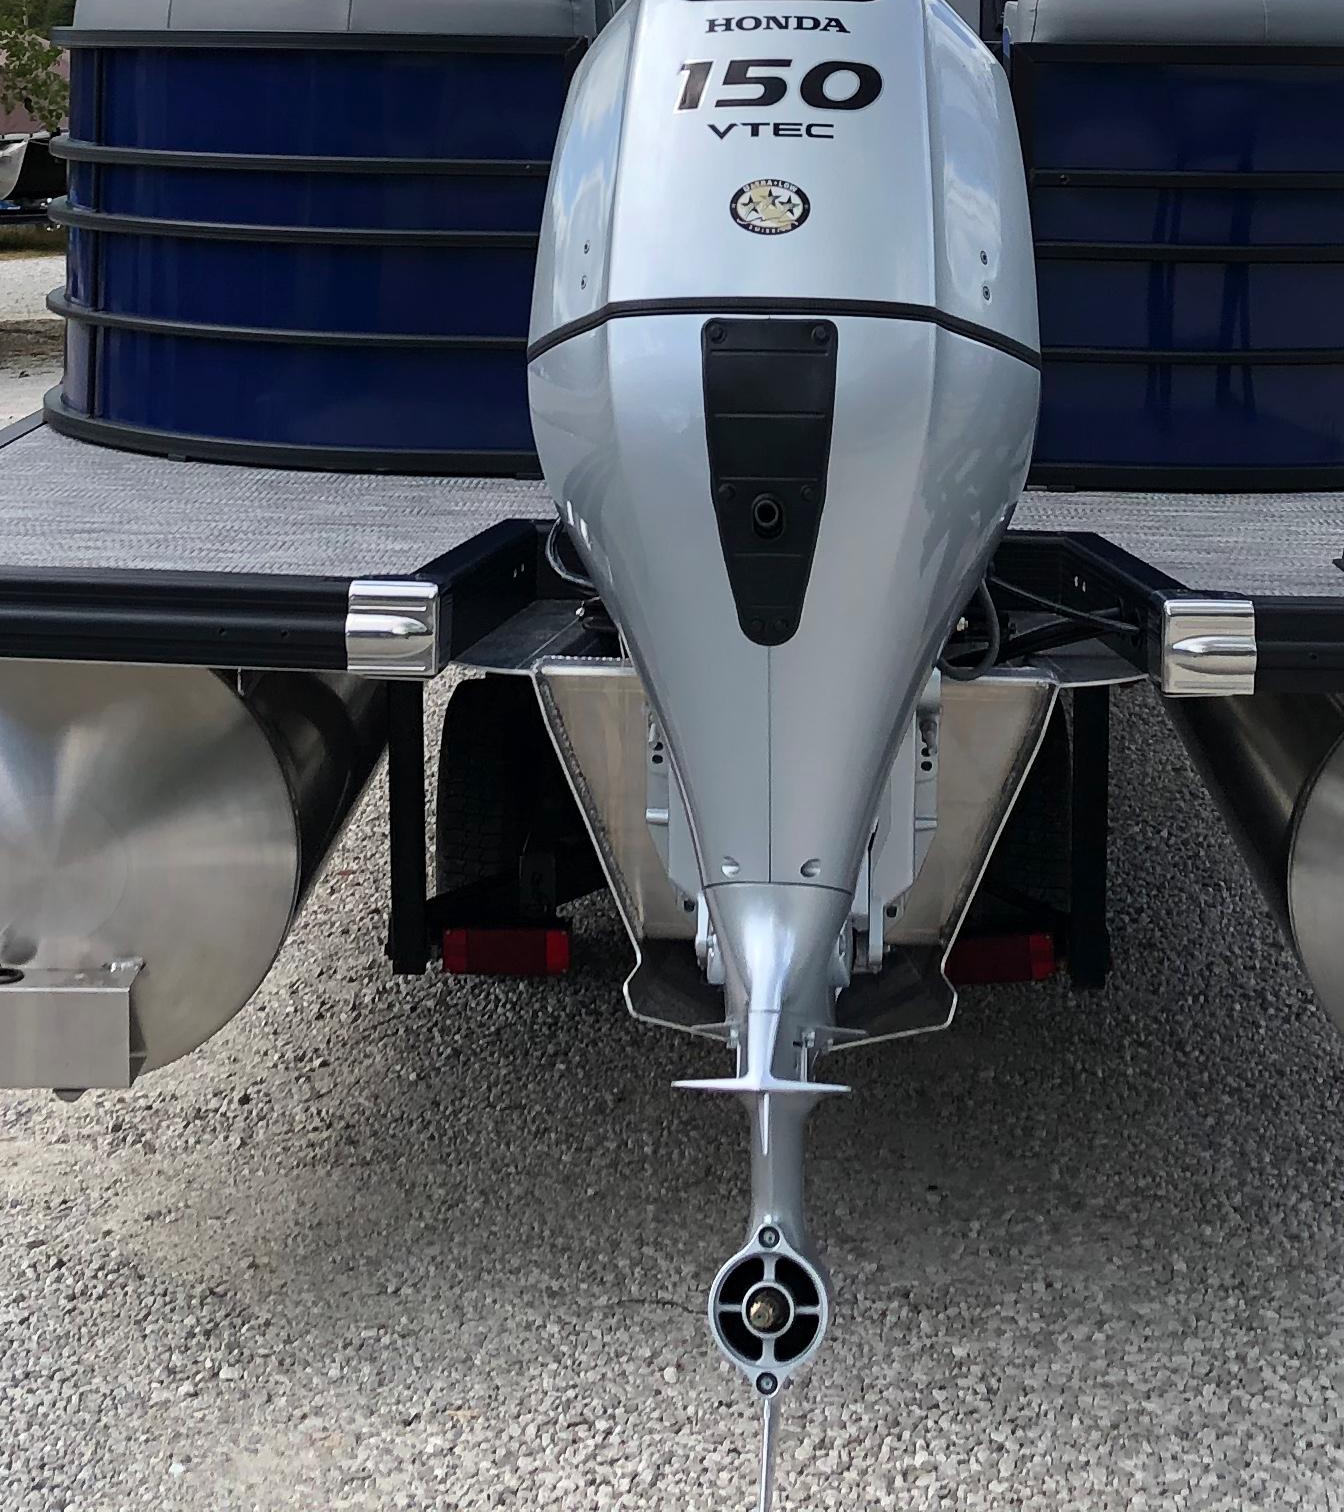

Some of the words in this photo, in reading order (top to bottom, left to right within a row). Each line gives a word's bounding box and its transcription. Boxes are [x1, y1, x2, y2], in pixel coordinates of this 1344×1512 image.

[706, 15, 851, 34] HONDA
[676, 59, 883, 111] 150
[707, 122, 835, 140] VTEC
